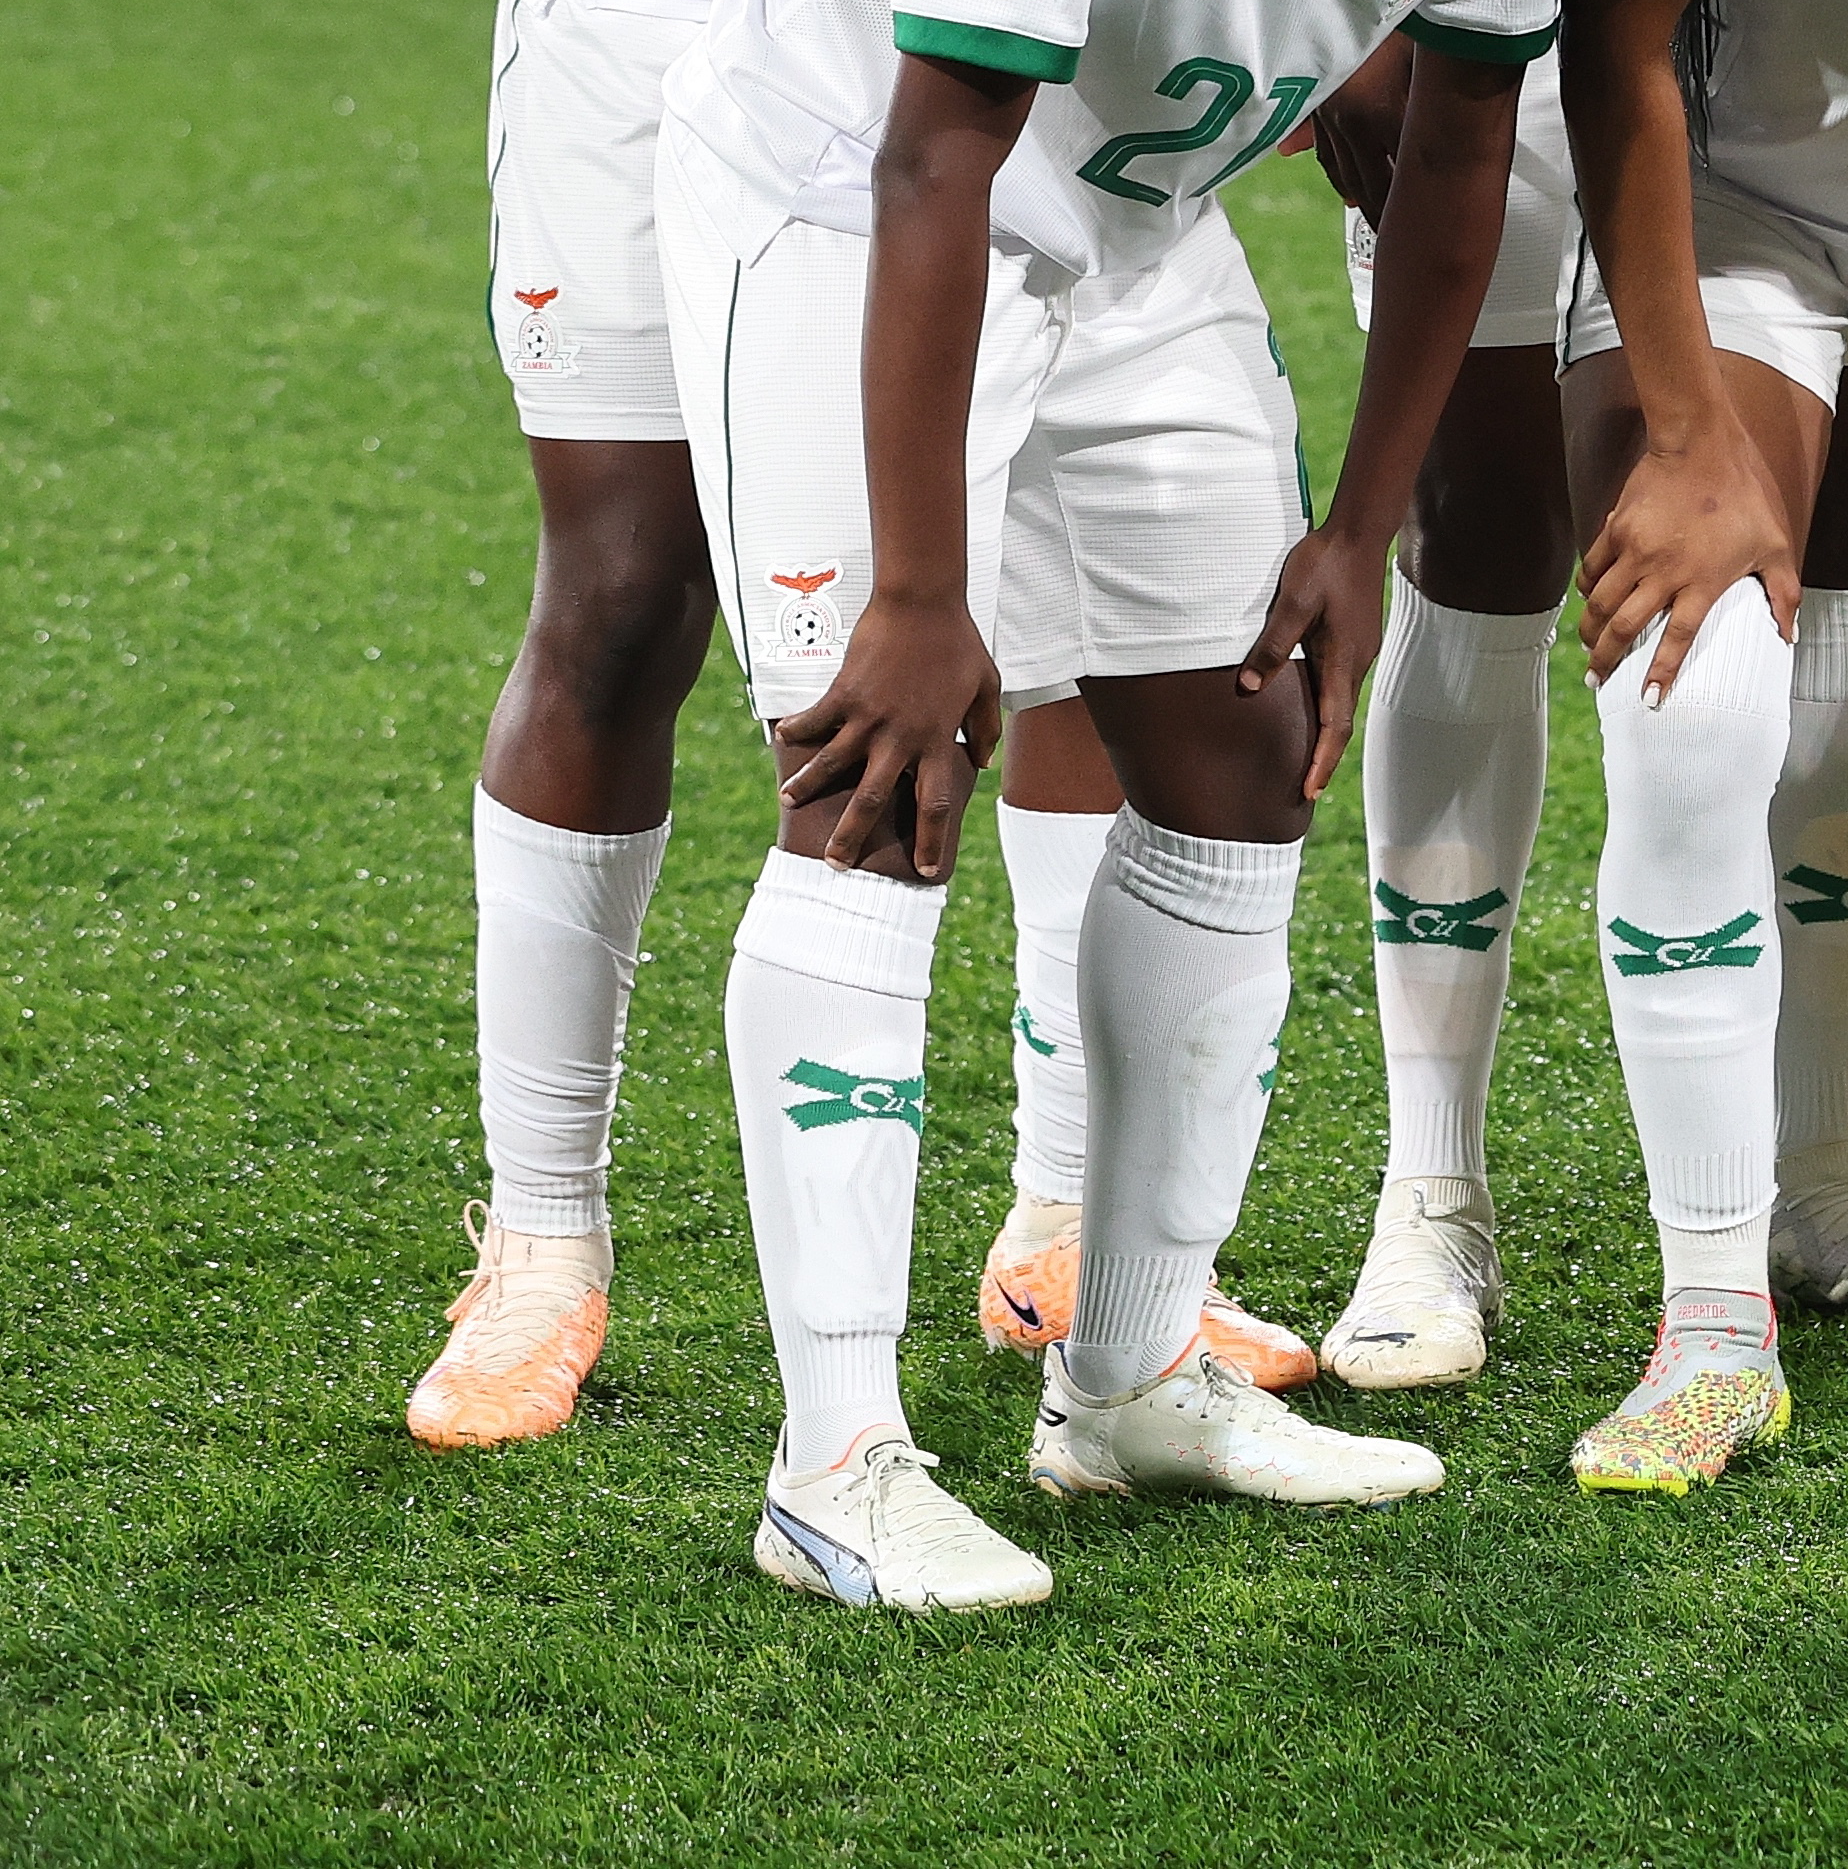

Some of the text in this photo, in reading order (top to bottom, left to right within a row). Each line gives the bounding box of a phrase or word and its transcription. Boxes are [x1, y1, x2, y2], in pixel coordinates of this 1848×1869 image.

[1077, 57, 1318, 208] 21
[522, 361, 553, 370] ZAMBIA
[787, 648, 833, 658] ZAMBIA
[1676, 1303, 1730, 1320] PREDATOR
